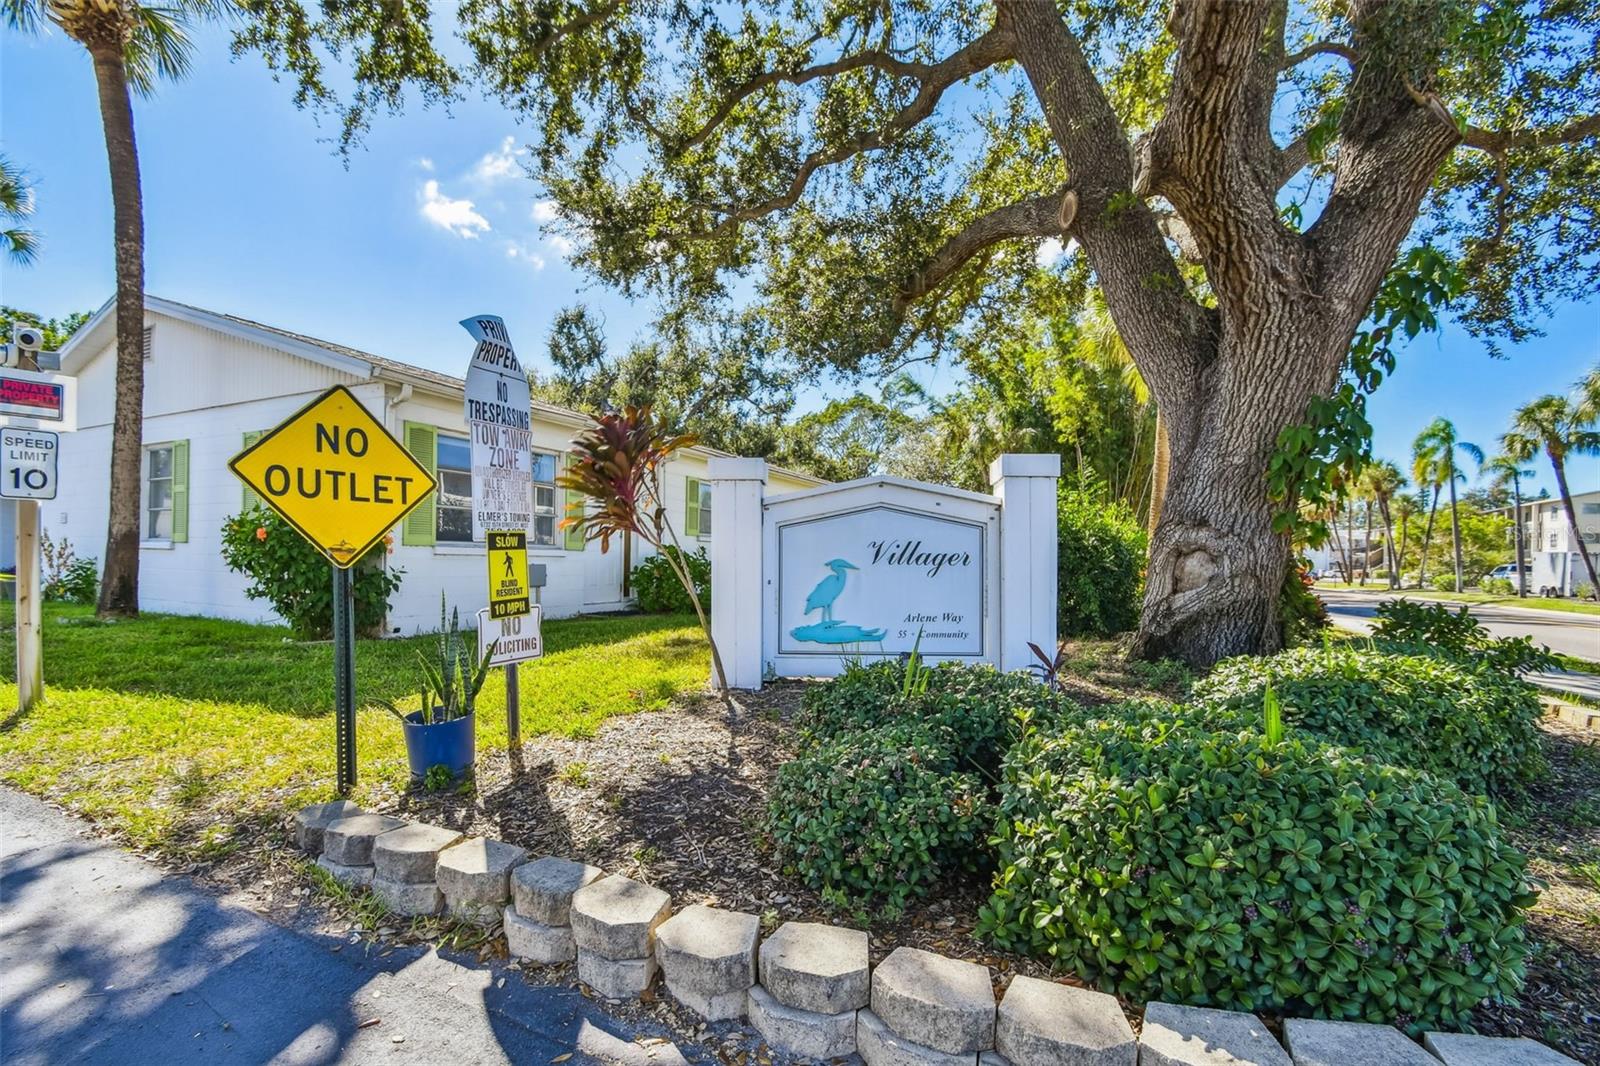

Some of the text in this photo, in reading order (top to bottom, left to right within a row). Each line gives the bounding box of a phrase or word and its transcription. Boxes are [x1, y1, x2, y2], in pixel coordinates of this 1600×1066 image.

[3, 379, 53, 395] PRIVATE
[497, 380, 508, 403] NO
[0, 388, 59, 404] PROPERTY
[468, 399, 529, 430] TRESPASSING
[4, 436, 55, 450] SPEED
[316, 423, 369, 458] NO
[473, 422, 530, 452] TOW AWAY
[10, 450, 49, 462] LIMIT
[489, 447, 520, 470] ZONE
[10, 467, 48, 490] 10
[264, 464, 414, 505] OUTLET
[478, 511, 530, 523] ELMER'S TOWING
[496, 536, 519, 548] SLOW
[867, 540, 972, 578] Villager
[496, 587, 523, 597] RESIDENT
[495, 601, 526, 615] 10 MPH
[903, 612, 964, 624] Arlene Way
[502, 616, 521, 637] NO
[897, 629, 907, 639] 55
[919, 629, 969, 640] Community
